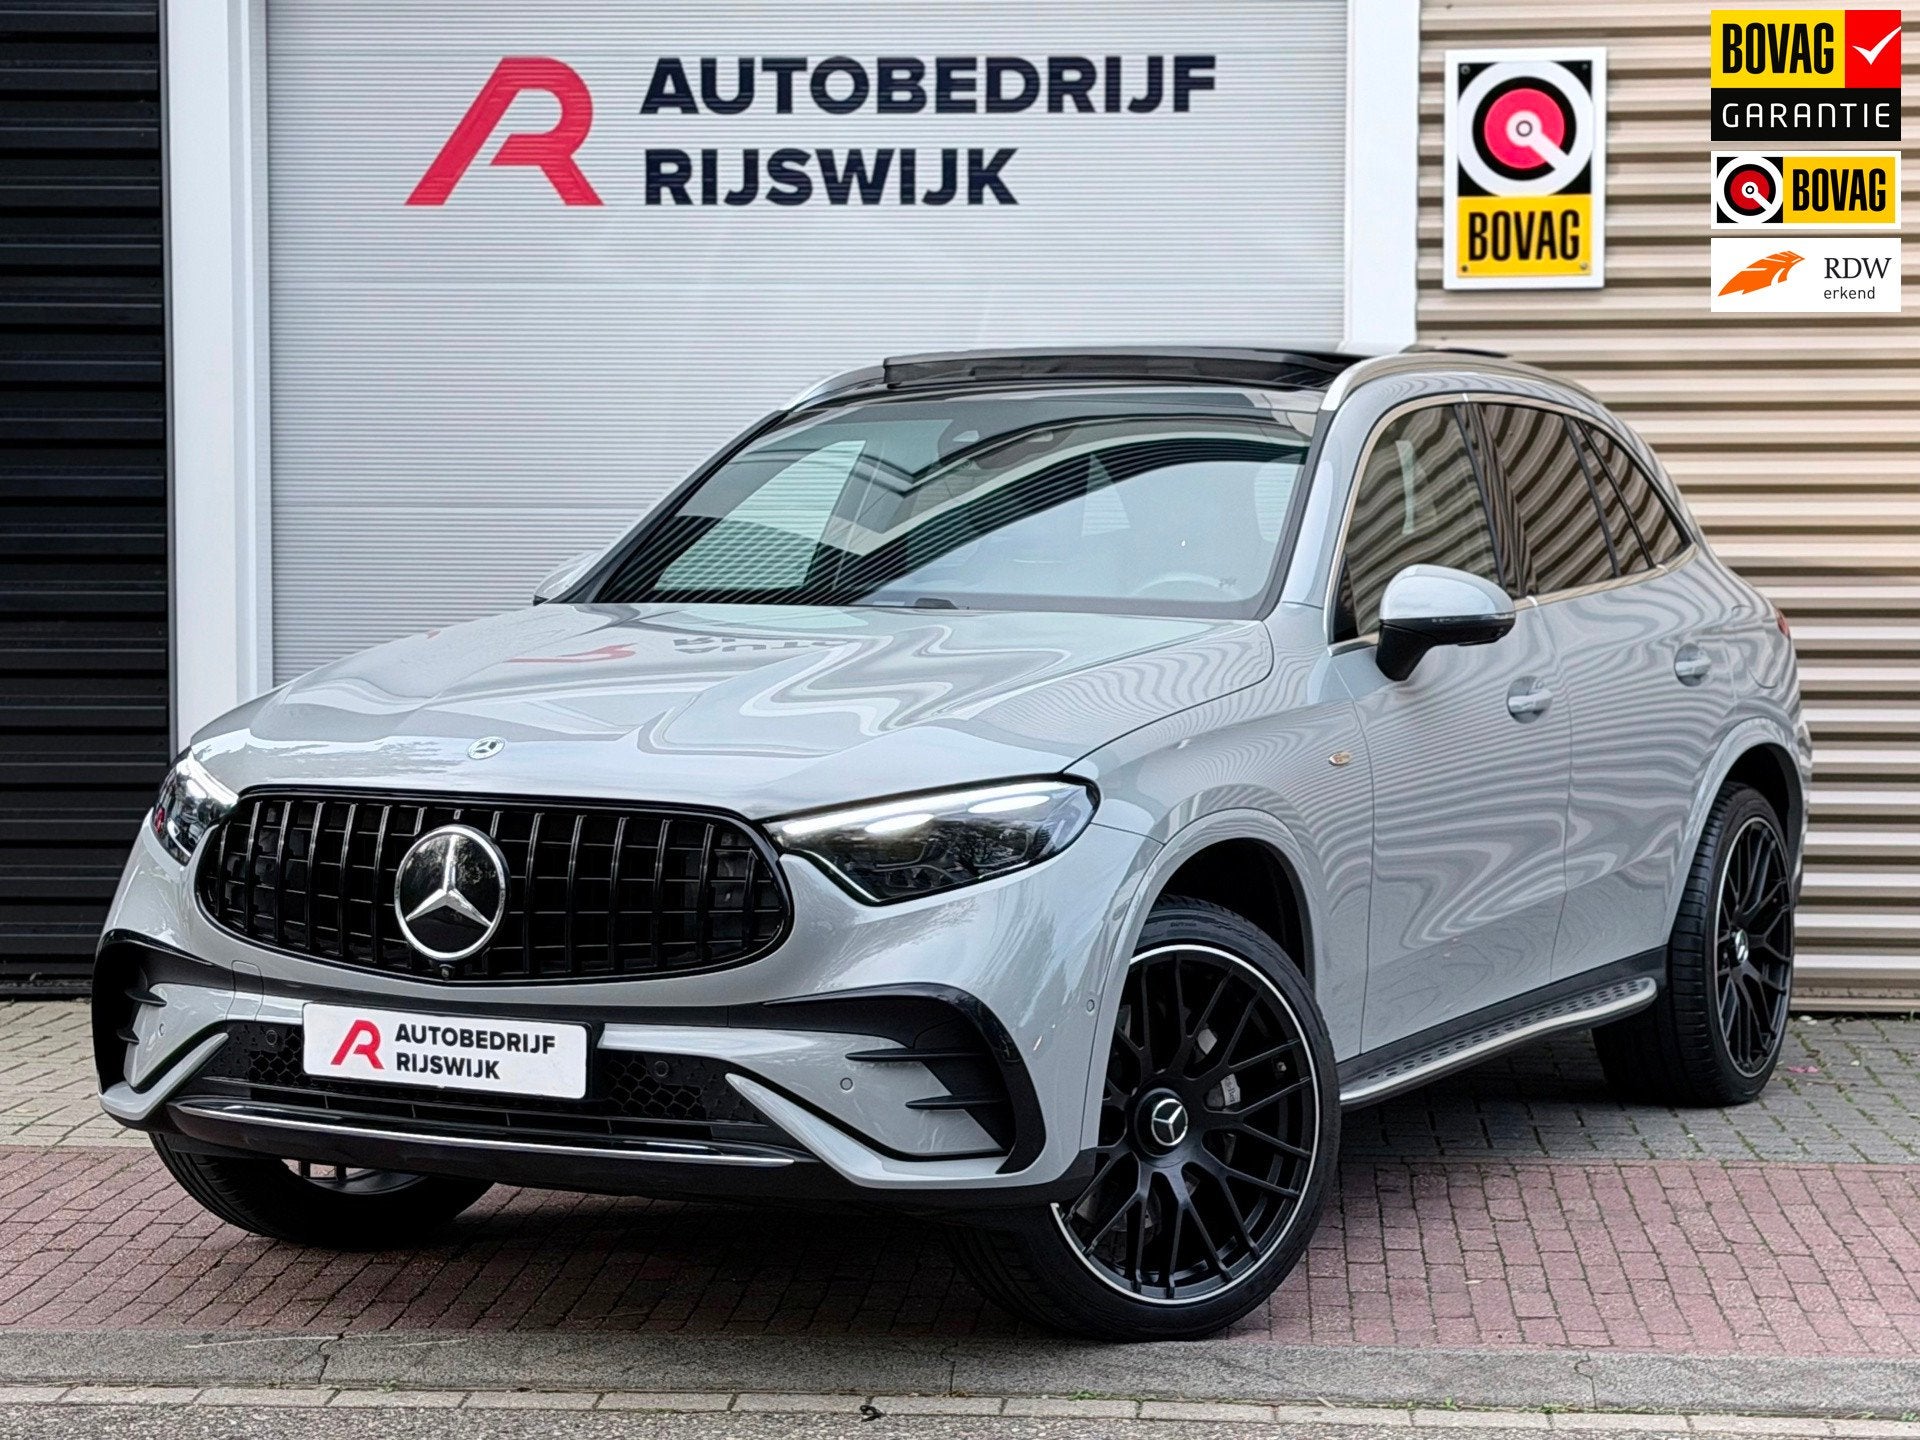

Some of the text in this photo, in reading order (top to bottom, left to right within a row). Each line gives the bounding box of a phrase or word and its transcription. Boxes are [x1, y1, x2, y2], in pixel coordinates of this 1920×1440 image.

[640, 55, 1216, 114] AUTOBEDRIJF
[645, 148, 1018, 205] RIJSWIJK
[1468, 209, 1580, 262] BOVAG
[395, 1023, 556, 1054] AUTOBEDRIJF
[396, 1052, 501, 1080] RIJSWIJK
